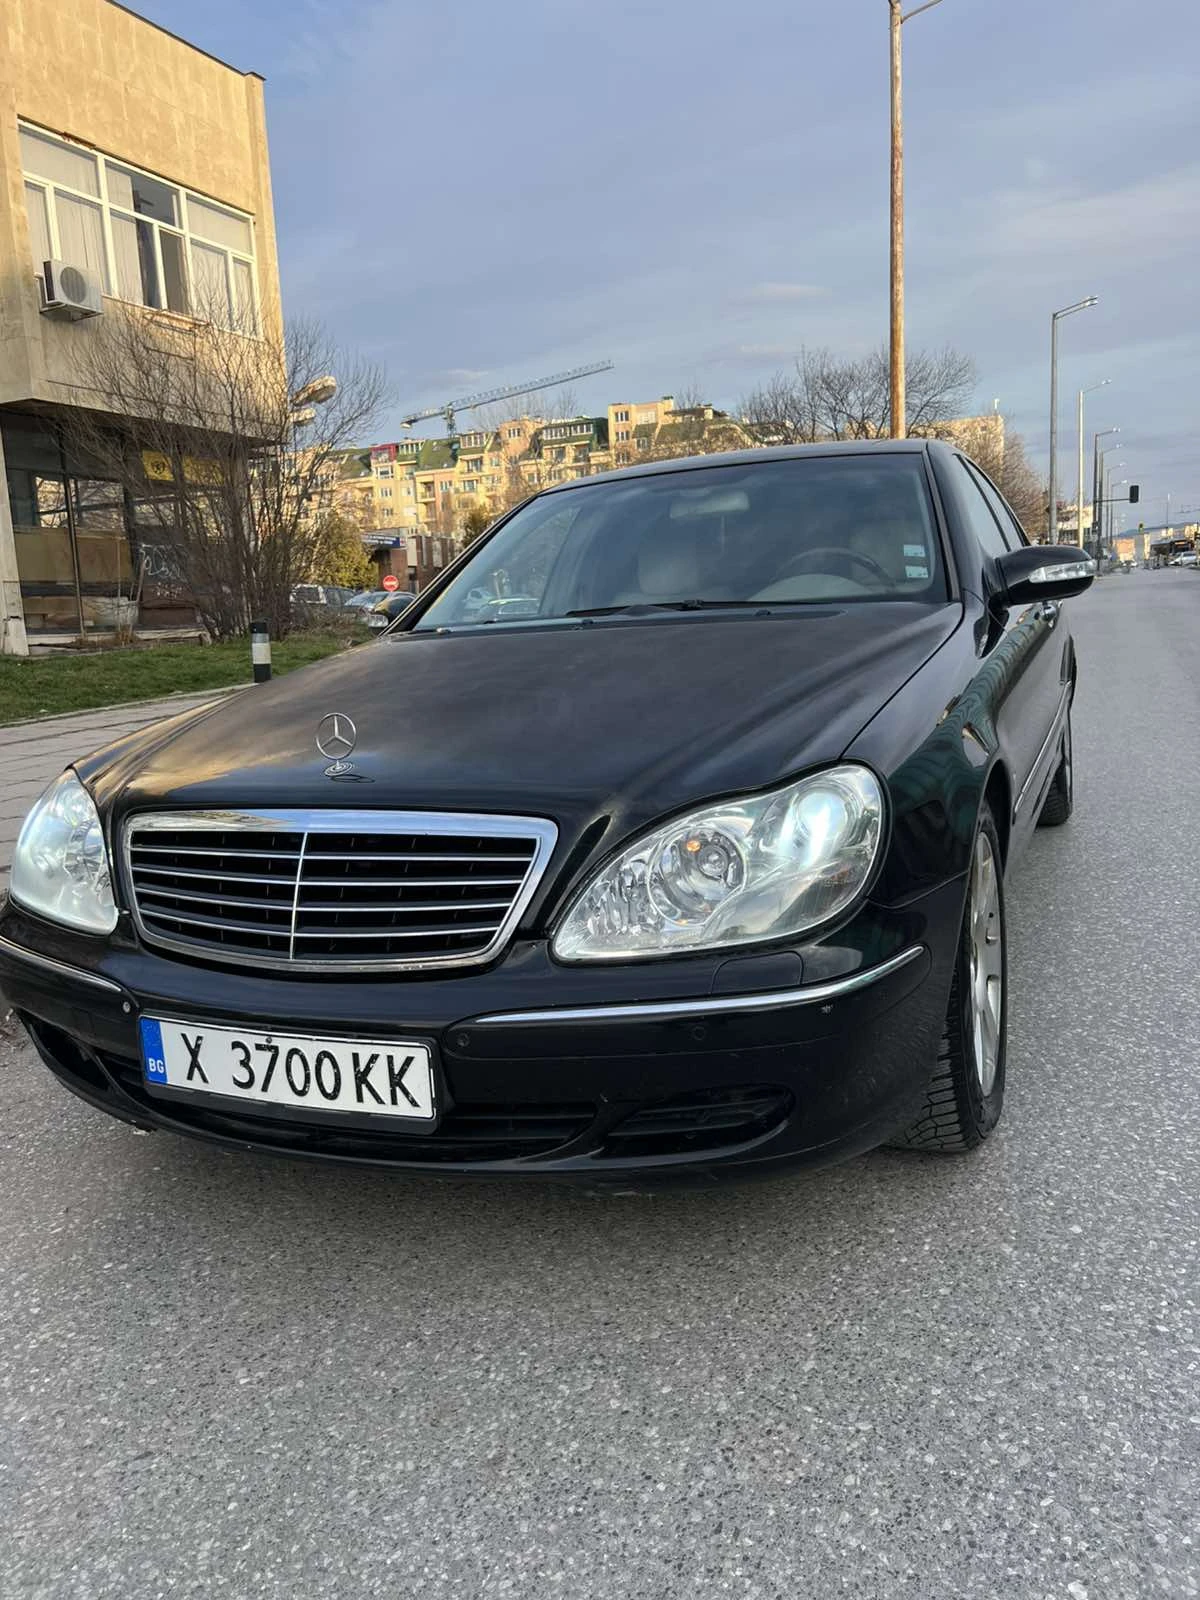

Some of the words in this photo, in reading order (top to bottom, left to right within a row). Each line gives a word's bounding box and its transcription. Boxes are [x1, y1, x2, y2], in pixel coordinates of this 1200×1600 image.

[148, 1058, 165, 1074] BG
[180, 1033, 209, 1084] X
[231, 1040, 342, 1100] 3700
[352, 1052, 421, 1107] KK
